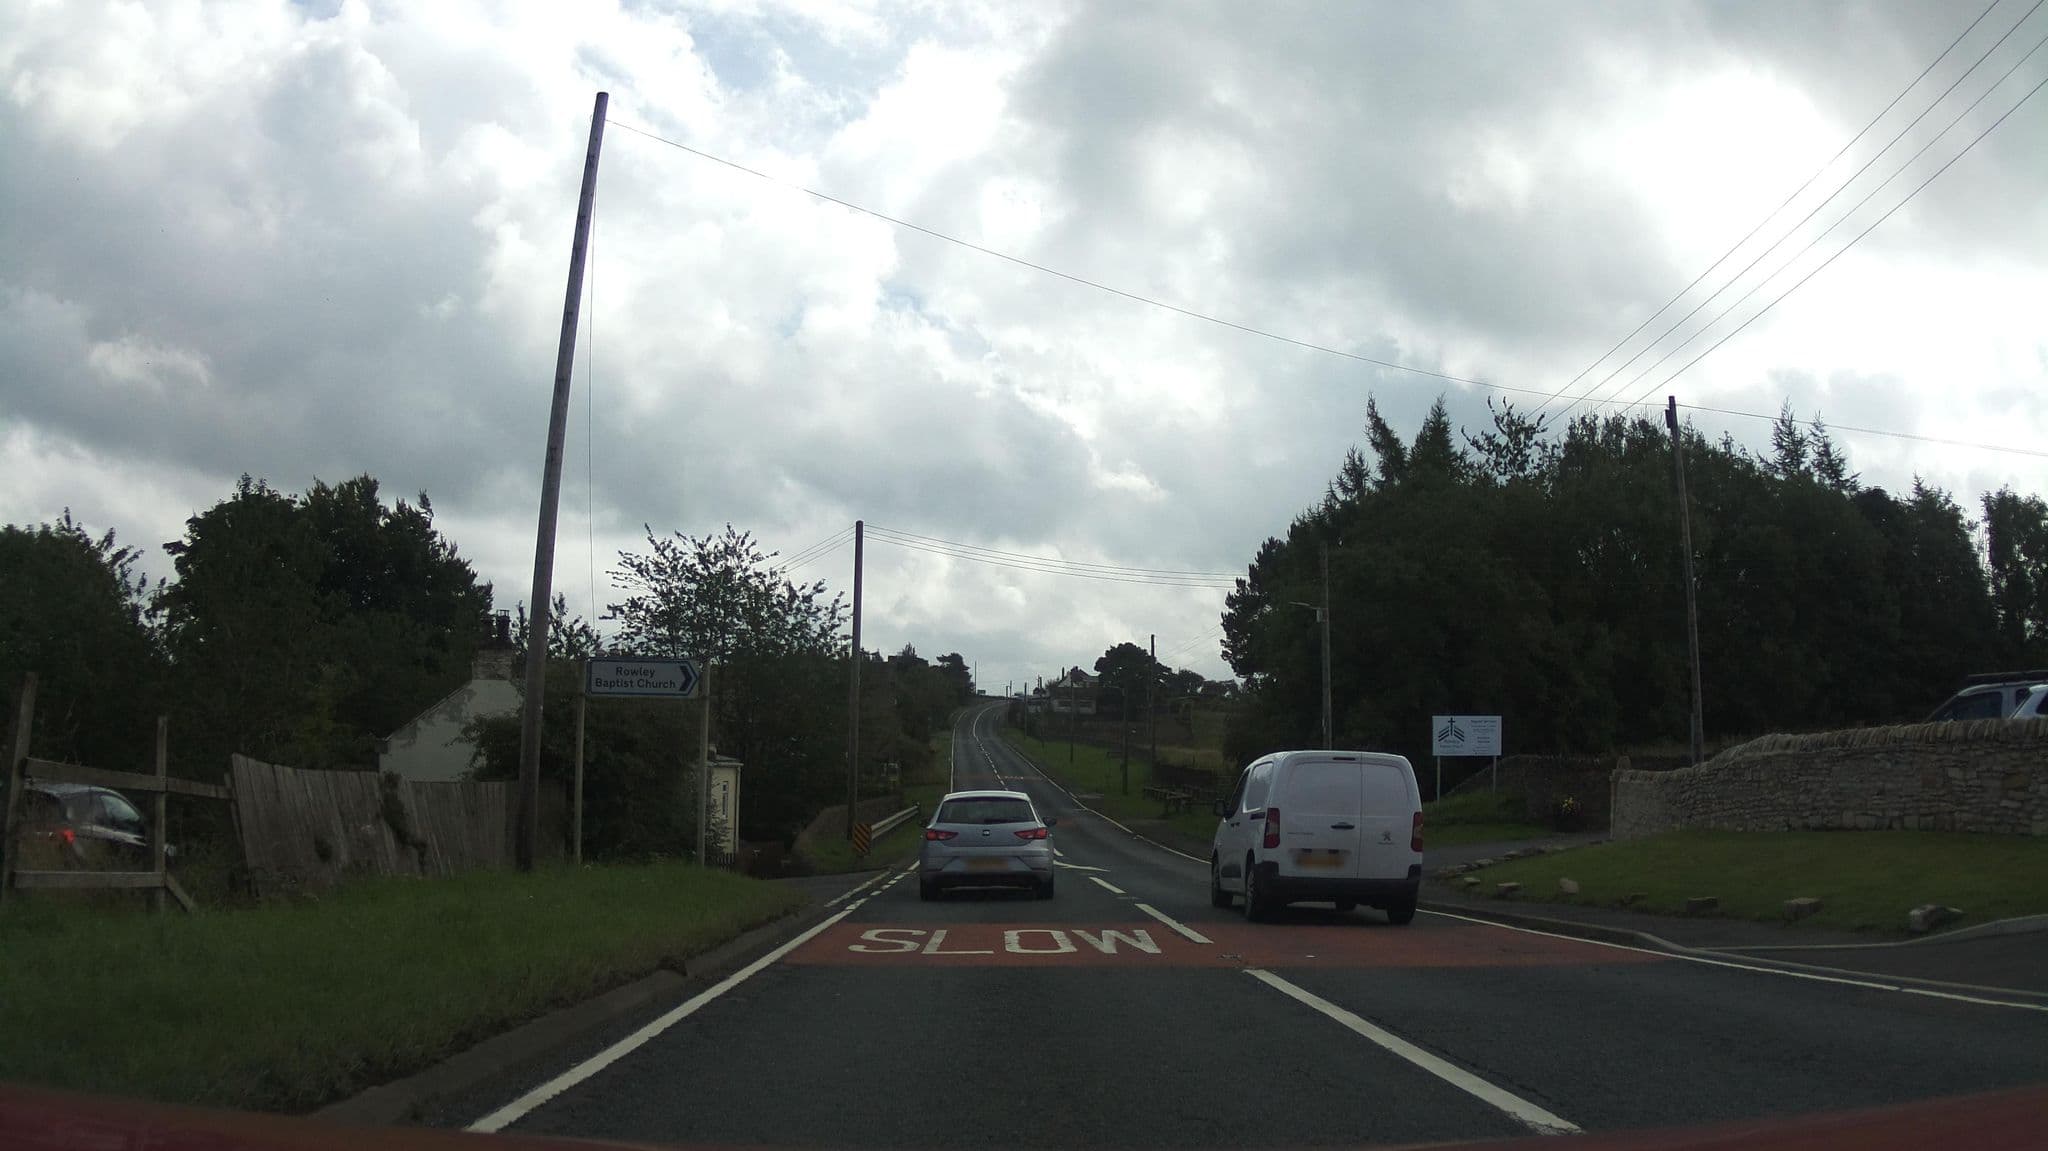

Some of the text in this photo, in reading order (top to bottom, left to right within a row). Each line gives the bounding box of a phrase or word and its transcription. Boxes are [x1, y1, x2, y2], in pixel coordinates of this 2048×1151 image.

[616, 666, 656, 679] Rowley
[595, 678, 676, 690] Baptist Church
[848, 928, 1162, 954] SLOW
